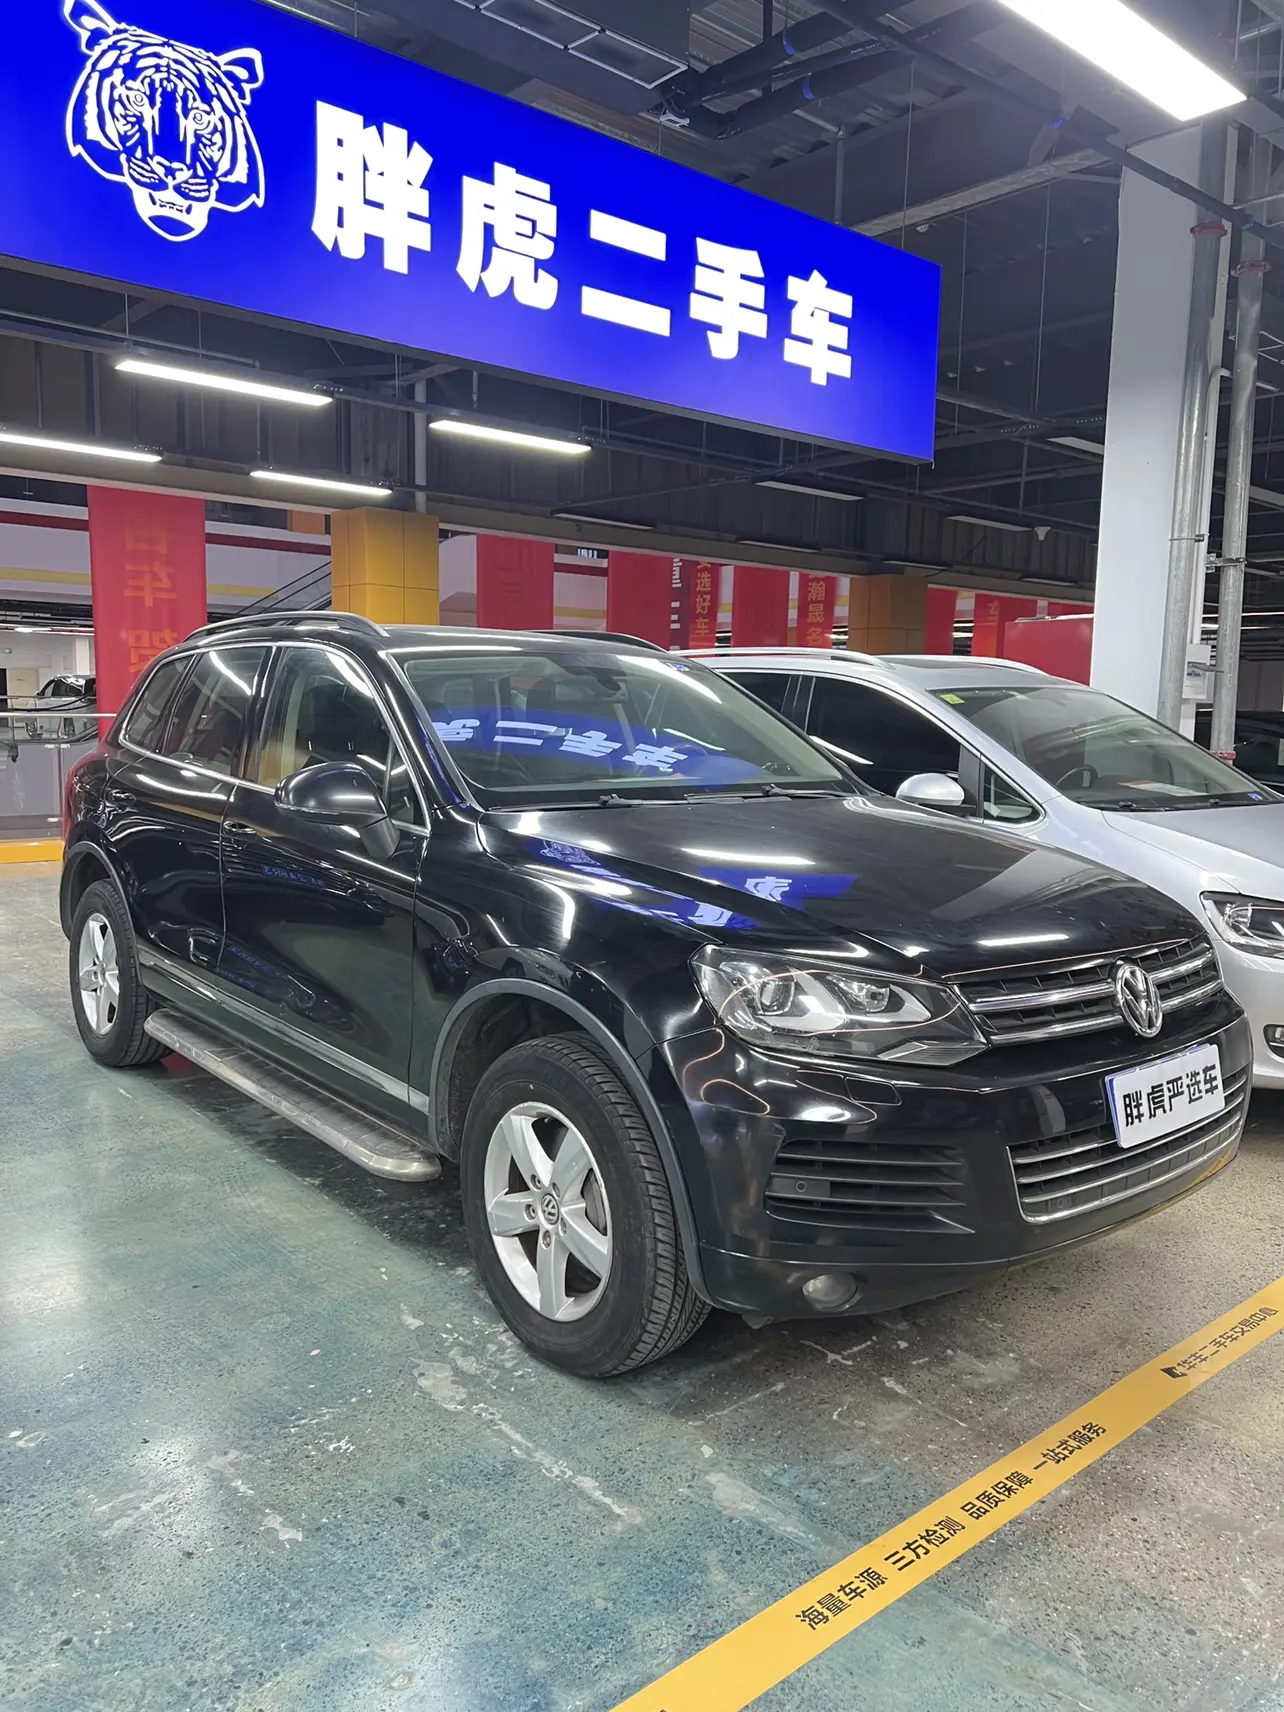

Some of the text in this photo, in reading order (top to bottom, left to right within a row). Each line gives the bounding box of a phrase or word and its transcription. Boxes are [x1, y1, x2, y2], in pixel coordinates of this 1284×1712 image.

[311, 100, 855, 385] 胖虎二手车
[806, 574, 826, 647] 瀚晟名
[1122, 1063, 1219, 1127] 胖虎严选车
[795, 1422, 1107, 1630] 海量车源 三方检测 品质保障 一站式服务
